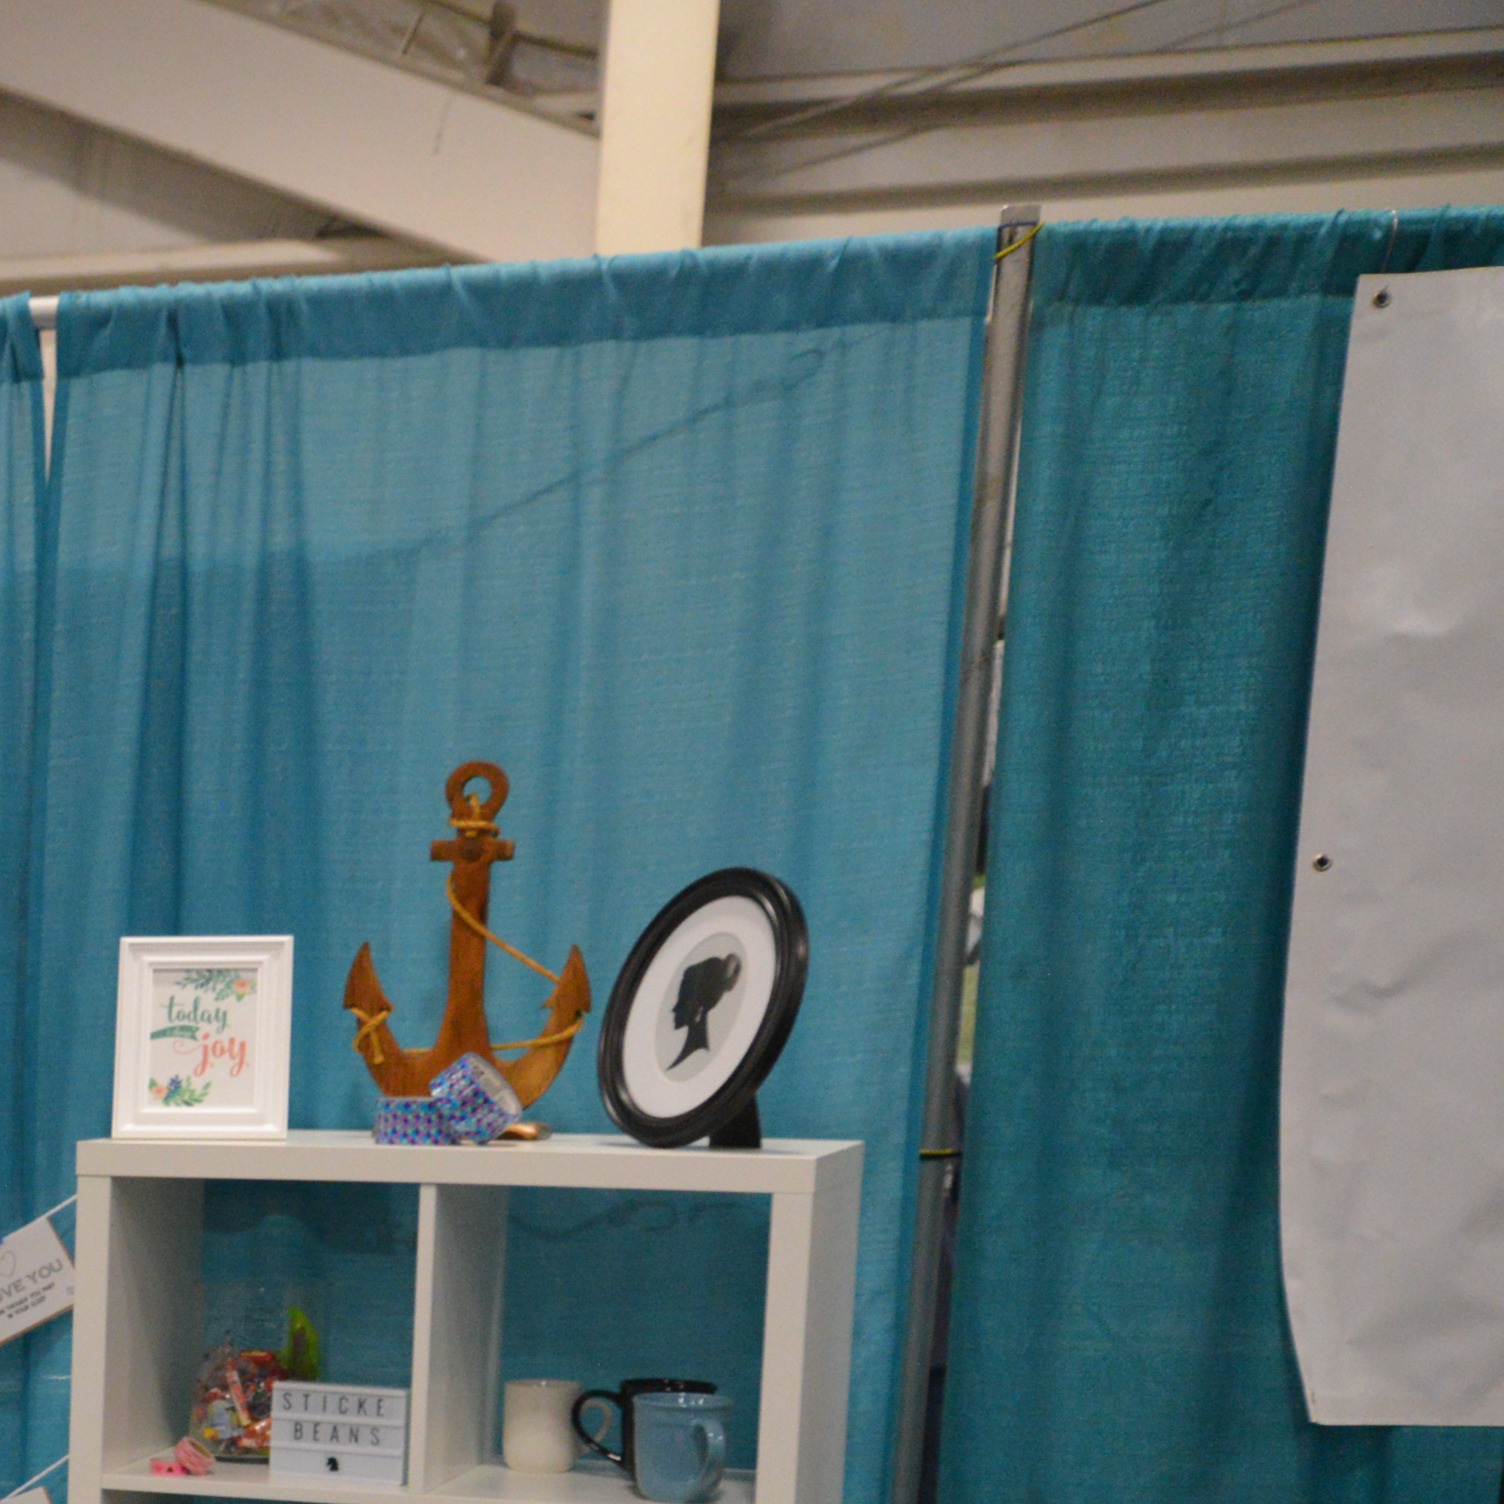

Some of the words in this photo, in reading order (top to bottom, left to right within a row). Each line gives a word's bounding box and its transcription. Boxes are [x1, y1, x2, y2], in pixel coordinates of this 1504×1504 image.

[162, 995, 230, 1035] today
[185, 1032, 251, 1077] joy
[25, 1257, 65, 1284] YOU
[280, 1391, 386, 1419] STICKE
[293, 1421, 382, 1447] BEANS
